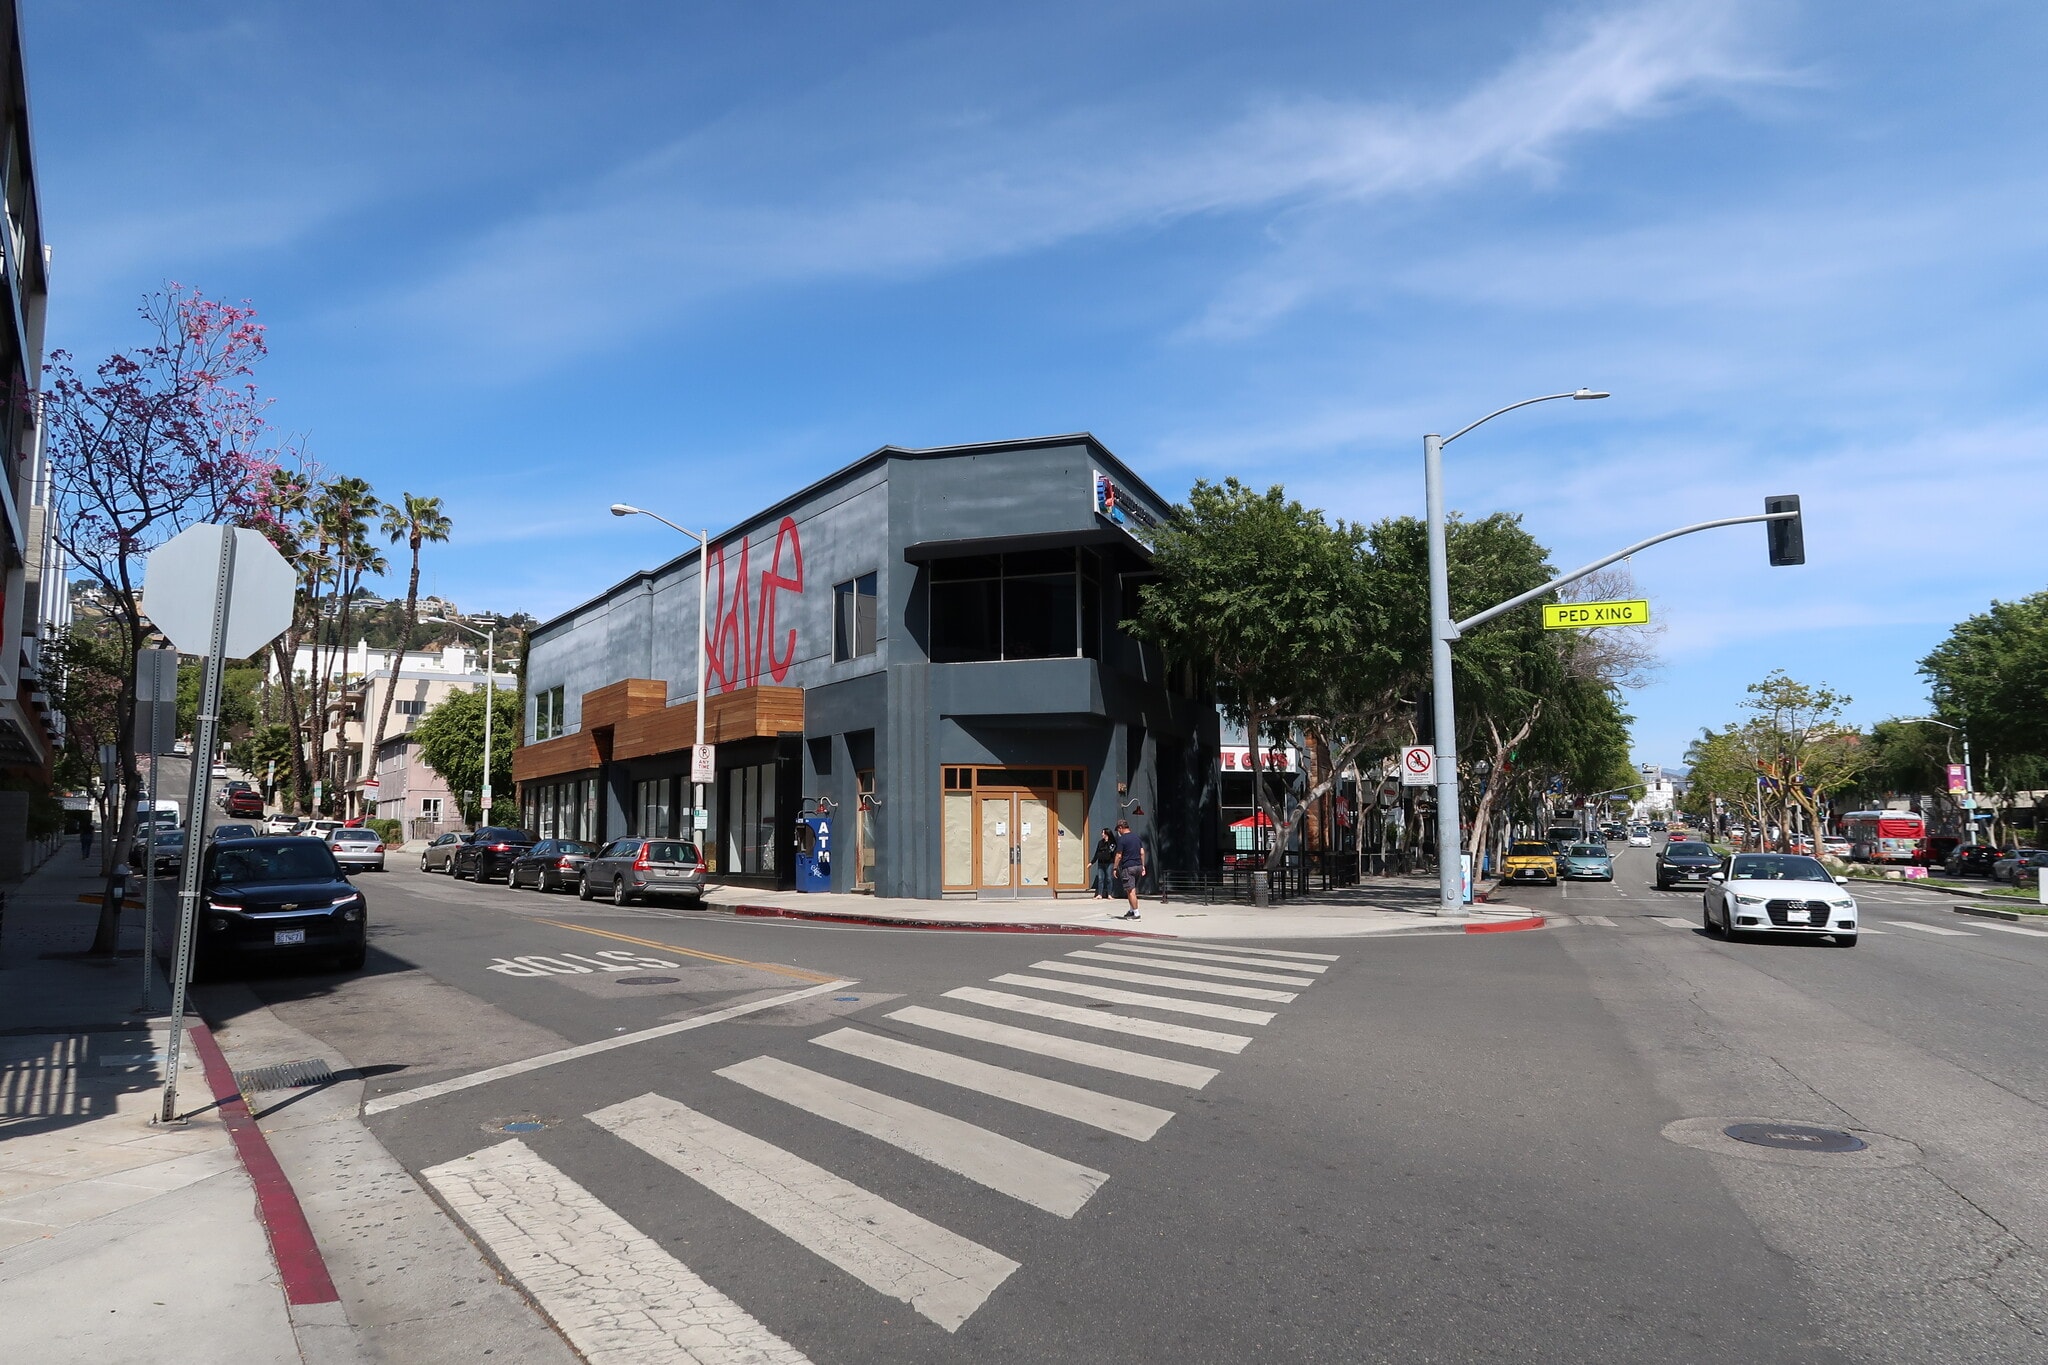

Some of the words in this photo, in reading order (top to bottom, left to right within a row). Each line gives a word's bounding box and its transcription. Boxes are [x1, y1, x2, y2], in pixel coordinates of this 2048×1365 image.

[1559, 610, 1589, 622] PED
[1595, 607, 1632, 620] XING
[817, 821, 831, 863] ATM
[486, 950, 681, 977] STOP
